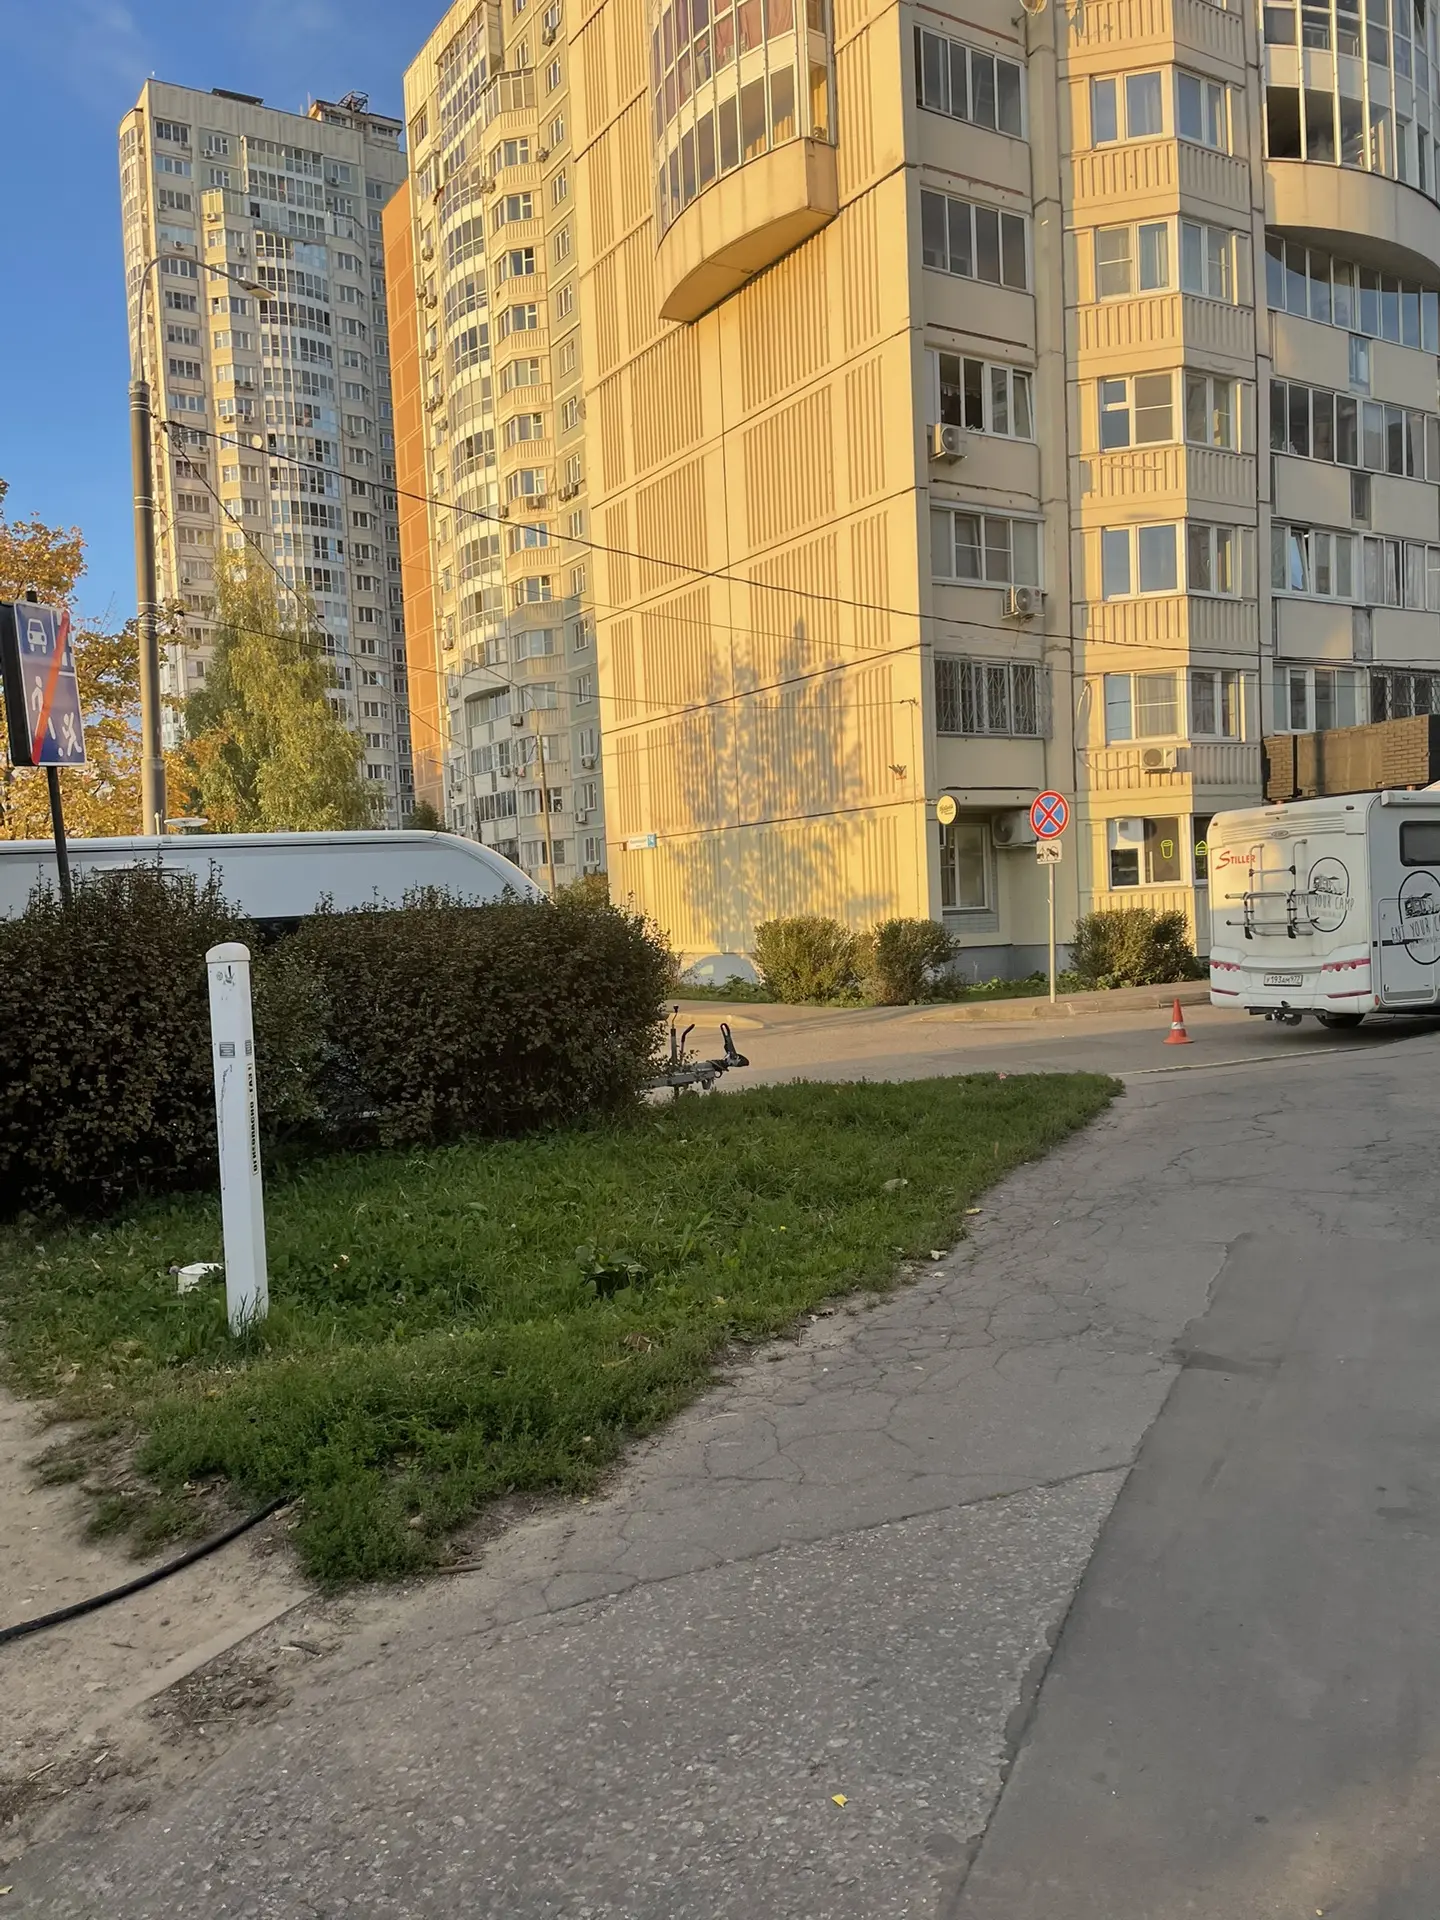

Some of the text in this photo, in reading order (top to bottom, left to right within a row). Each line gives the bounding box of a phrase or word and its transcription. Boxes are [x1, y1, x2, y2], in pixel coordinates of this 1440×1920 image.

[1215, 850, 1256, 870] STILLER
[1314, 894, 1331, 909] YOUR
[1410, 917, 1430, 937] YOUR
[250, 1101, 258, 1172] ОГНЕОПАСНО
